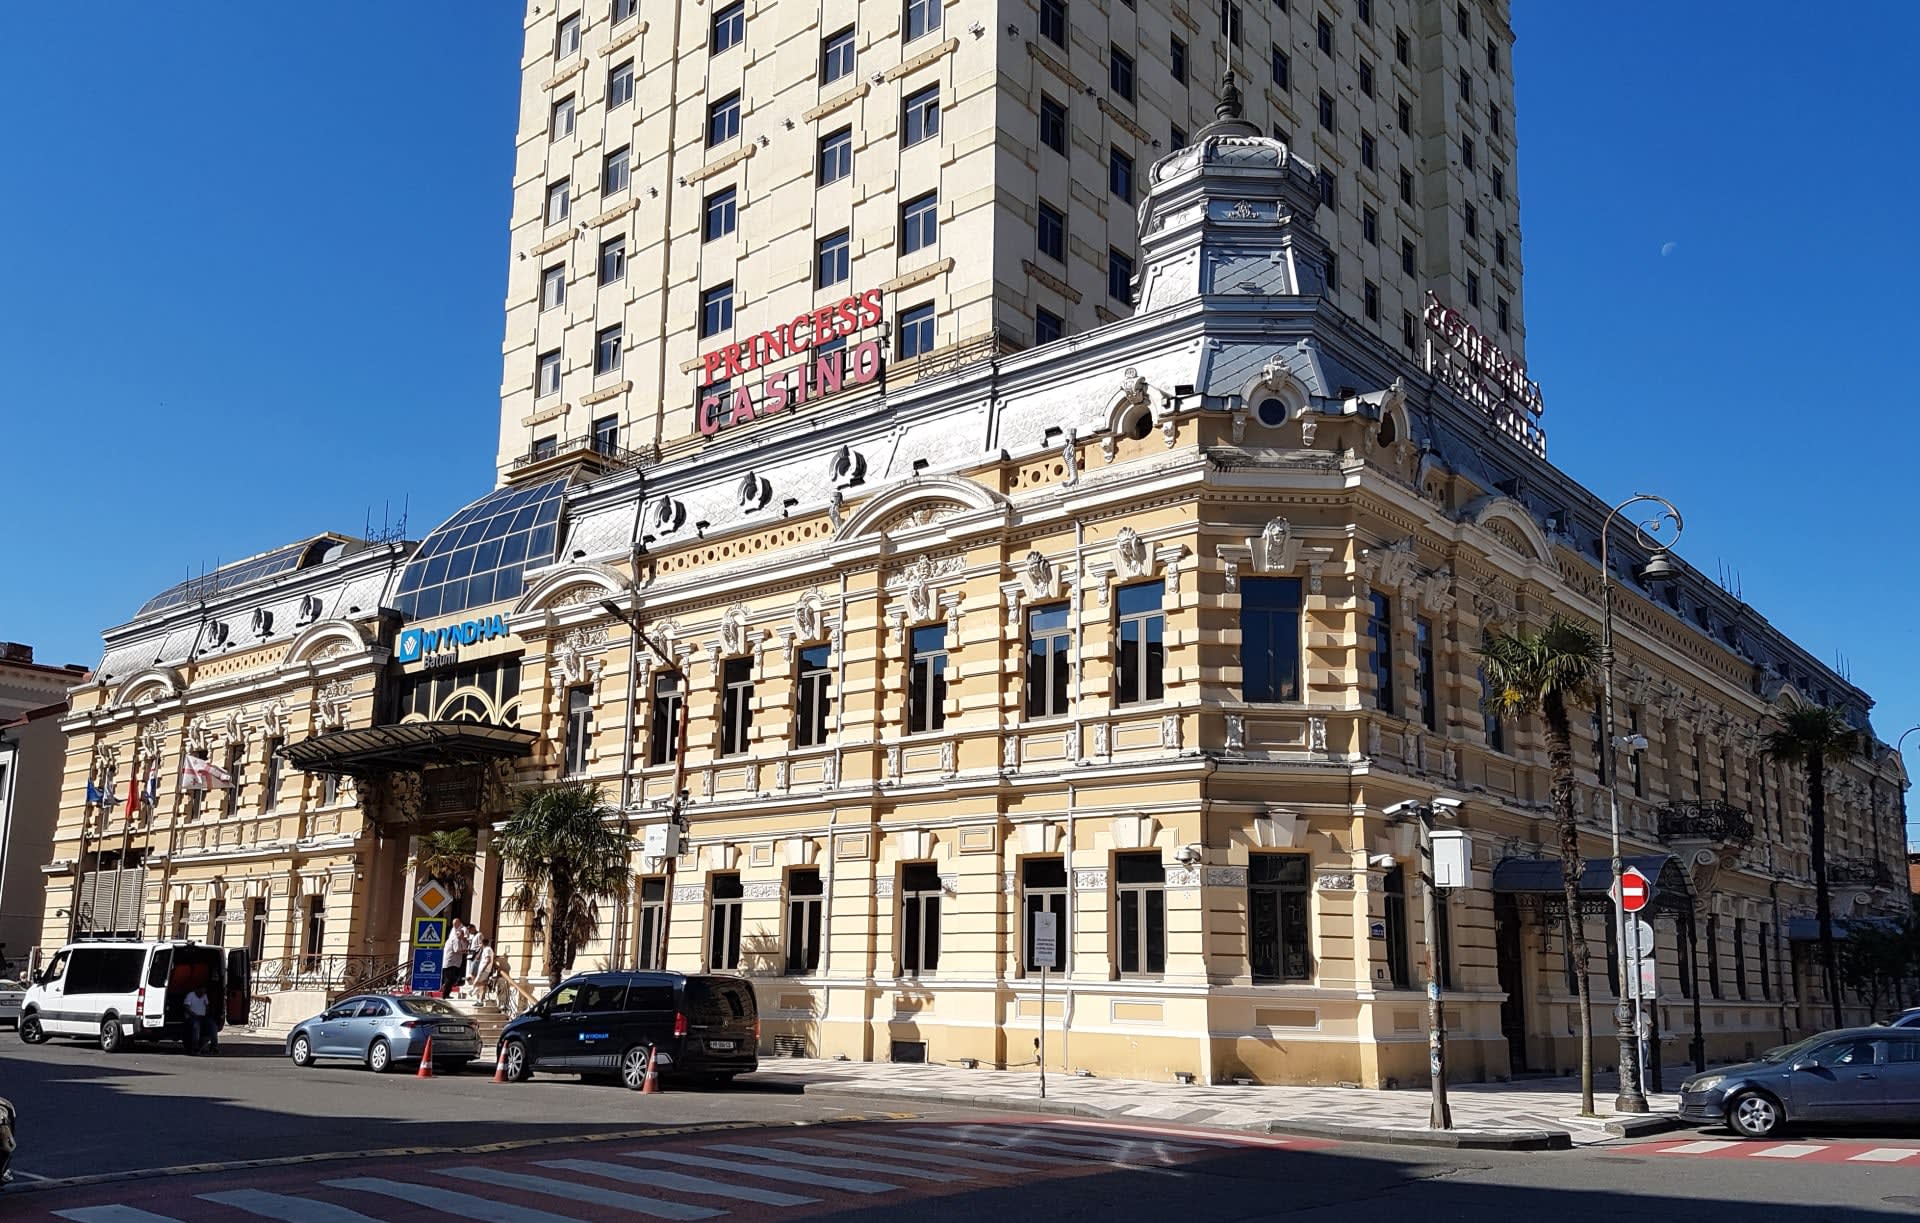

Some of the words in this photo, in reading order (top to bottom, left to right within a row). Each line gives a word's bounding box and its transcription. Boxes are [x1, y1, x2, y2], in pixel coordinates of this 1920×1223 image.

[703, 288, 883, 387] PRINCESS
[700, 340, 881, 435] CASINO
[424, 652, 457, 669] Batumi
